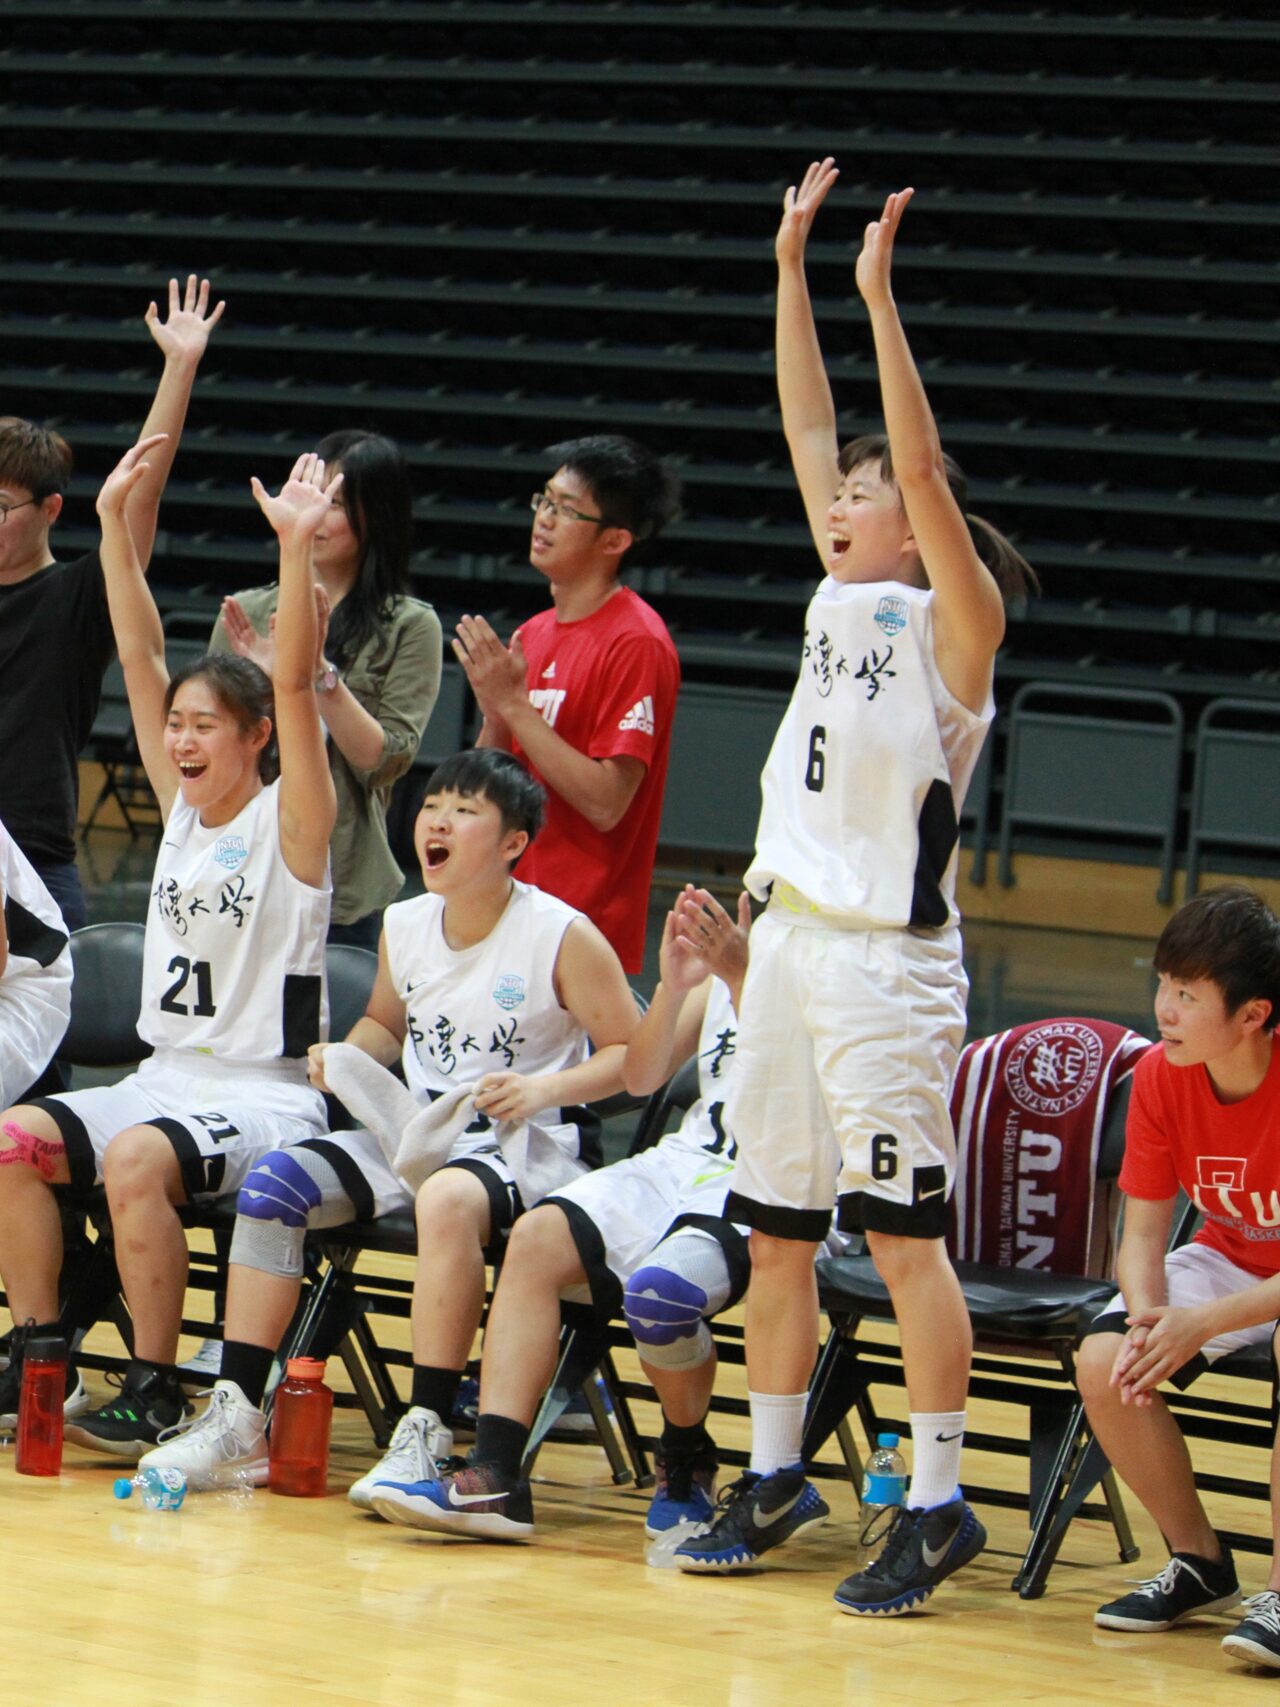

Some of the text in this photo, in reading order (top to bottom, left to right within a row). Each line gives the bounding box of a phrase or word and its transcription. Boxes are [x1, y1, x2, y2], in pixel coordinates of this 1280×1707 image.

[805, 725, 826, 793] 6
[160, 955, 216, 1017] 21
[1008, 1026, 1100, 1112] NATIONAL TAIWAN UNIVERSITY
[1063, 1046, 1085, 1083] NTU
[190, 1112, 240, 1144] 21
[872, 1134, 897, 1180] 6
[998, 1109, 1021, 1267] ONAL TAIWAN UNIVERSITY
[1016, 1129, 1062, 1273] NTU
